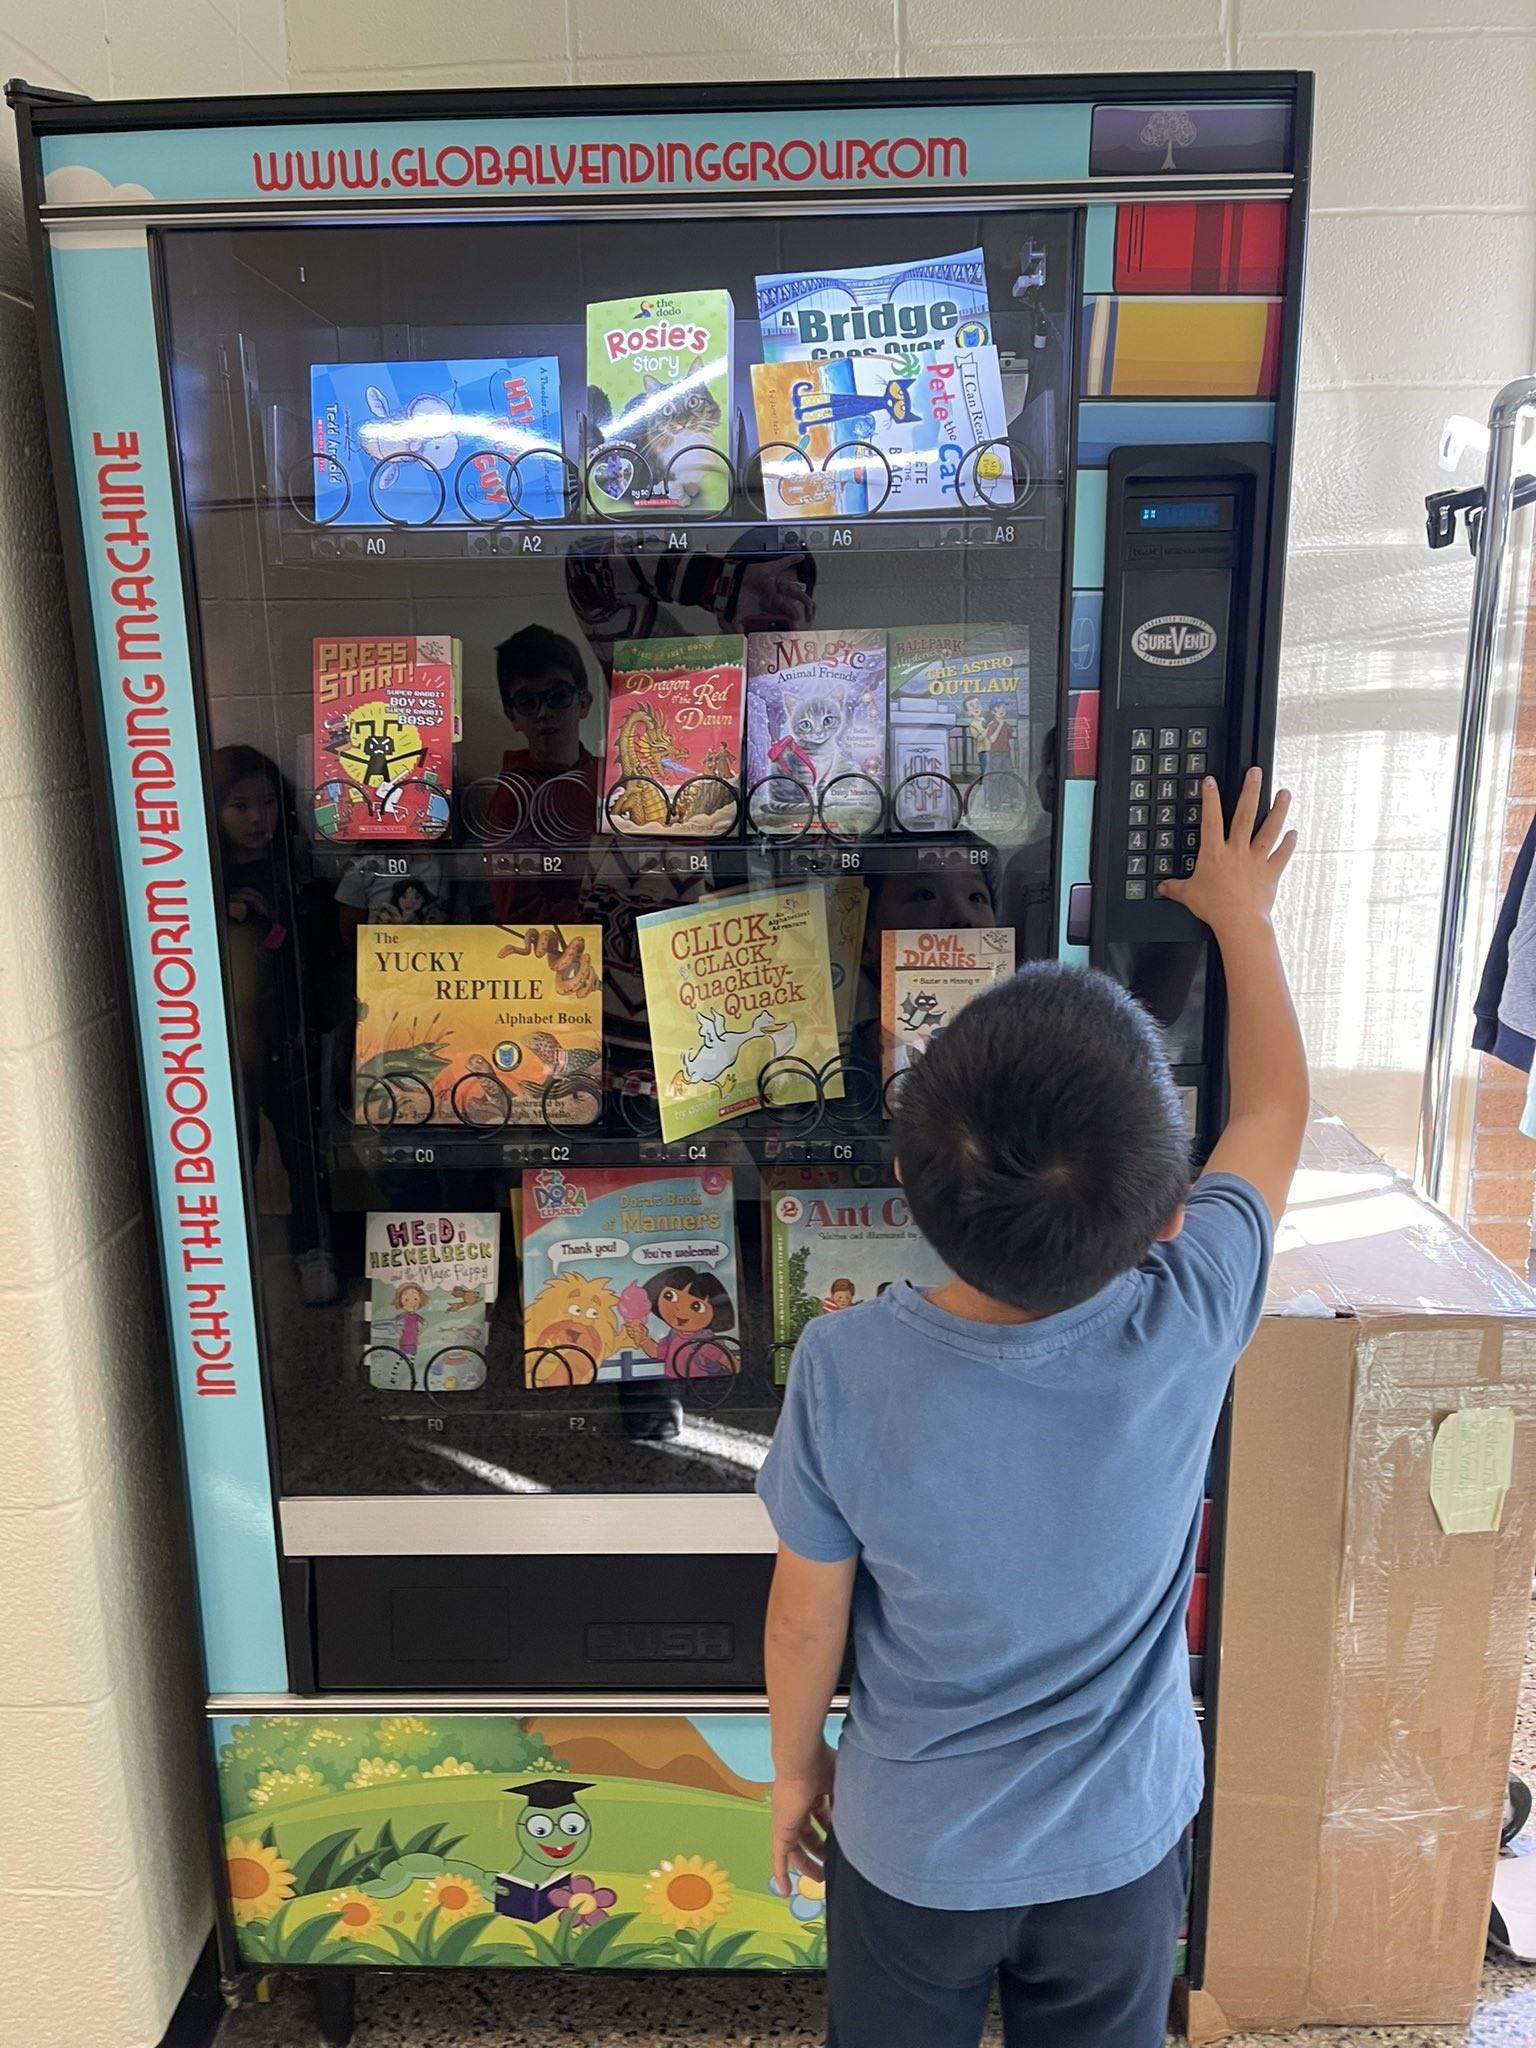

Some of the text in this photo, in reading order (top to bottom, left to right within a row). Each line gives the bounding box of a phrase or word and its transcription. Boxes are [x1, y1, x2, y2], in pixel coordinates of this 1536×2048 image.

[656, 299, 674, 309] the
[656, 306, 681, 317] dodo
[781, 311, 795, 326] A
[797, 300, 960, 344] Bridge
[606, 321, 708, 360] Rosie's
[503, 375, 536, 425] HI!
[965, 382, 978, 407] Can
[325, 402, 340, 435] Tedd
[927, 363, 966, 495] Pete the Cat
[473, 453, 510, 504] GUY
[887, 447, 904, 494] BACH
[914, 457, 928, 485] ETE
[522, 535, 542, 552] A2
[668, 532, 689, 549] A4
[832, 530, 852, 546] A6
[994, 526, 1015, 543] A8
[366, 537, 386, 554] A0
[896, 637, 963, 656] BALLPARK
[319, 641, 408, 672] PRESS
[767, 638, 866, 675] Magic
[777, 666, 857, 684] Animal Friends
[926, 656, 1014, 681] THE ASTRO
[319, 659, 416, 704] START!
[626, 672, 692, 699] Dragon
[928, 676, 1020, 696] OUTLAW
[386, 688, 412, 698] SUPER
[693, 674, 734, 711] Red
[389, 697, 443, 709] BOY VS.
[397, 715, 444, 727] BOSS!
[674, 707, 732, 731] Dawn
[1135, 732, 1201, 746] A B C
[1136, 757, 1200, 772] D E F
[1135, 782, 1198, 797] G H J
[1136, 808, 1197, 822] 1 2 3
[1132, 833, 1196, 847] 4 5 6
[388, 858, 407, 874] B0
[543, 856, 562, 872] B2
[690, 856, 708, 870] B4
[841, 853, 860, 868] B6
[970, 850, 988, 865] B8
[1132, 857, 1194, 872] 7 8 9
[93, 430, 238, 1398] INCHY THE BOOKWORM VENDING MACHINE
[374, 932, 399, 944] The
[671, 911, 779, 961] CLICK,
[918, 933, 964, 953] OWL
[374, 951, 465, 973] YUCKY
[694, 943, 773, 978] CLACK,
[903, 949, 976, 968] DIARIES
[434, 979, 544, 1001] REPTILE
[679, 964, 793, 1011] Quackity-
[950, 977, 974, 987] Missing
[724, 981, 806, 1019] Quack
[495, 1012, 593, 1028] Alphabet Book
[415, 1149, 434, 1163] C0
[551, 1147, 570, 1161] C2
[688, 1146, 707, 1160] C4
[833, 1145, 852, 1159] C6
[533, 1183, 588, 1209] DORA
[782, 1200, 799, 1218] 2
[805, 1199, 874, 1228] Ant
[620, 1210, 722, 1234] Manners
[369, 1241, 492, 1270] HECKELBECK
[561, 1242, 617, 1257] Thank you!
[642, 1245, 720, 1260] You're welcome!
[453, 1263, 489, 1283] Puppy
[427, 1418, 443, 1432] F0
[569, 1417, 585, 1431] F2
